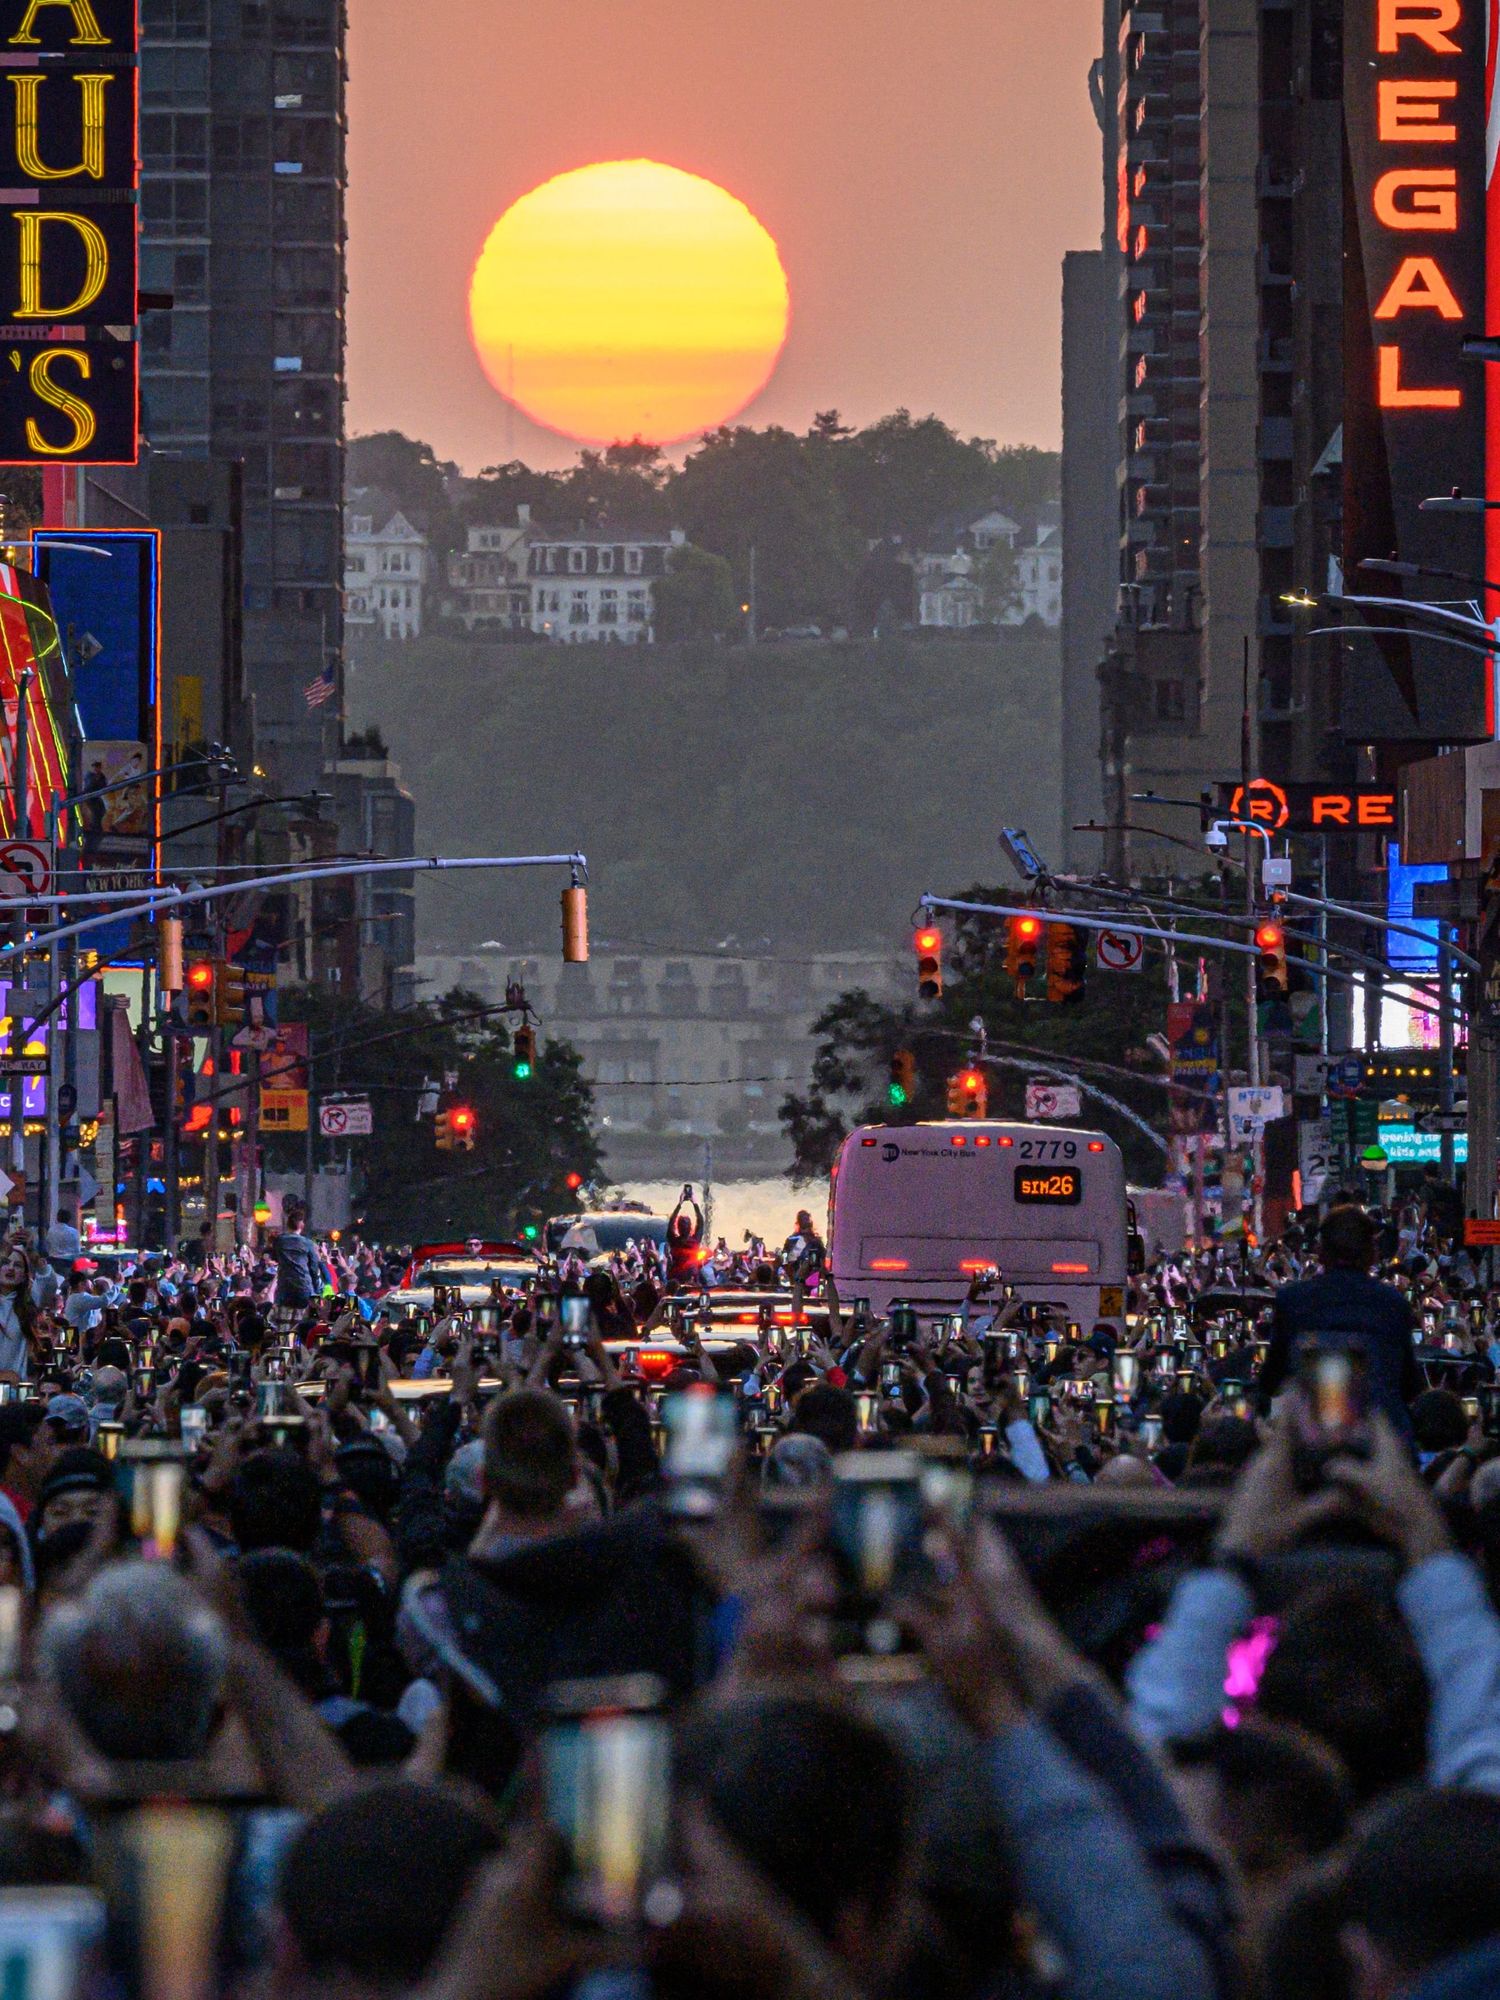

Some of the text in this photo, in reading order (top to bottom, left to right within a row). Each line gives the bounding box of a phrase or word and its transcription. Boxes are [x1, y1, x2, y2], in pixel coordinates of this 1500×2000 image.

[1372, 0, 1464, 408] REGAL
[1312, 795, 1394, 824] RE
[1019, 1140, 1078, 1160] 2779
[1021, 1174, 1074, 1195] SIM26
